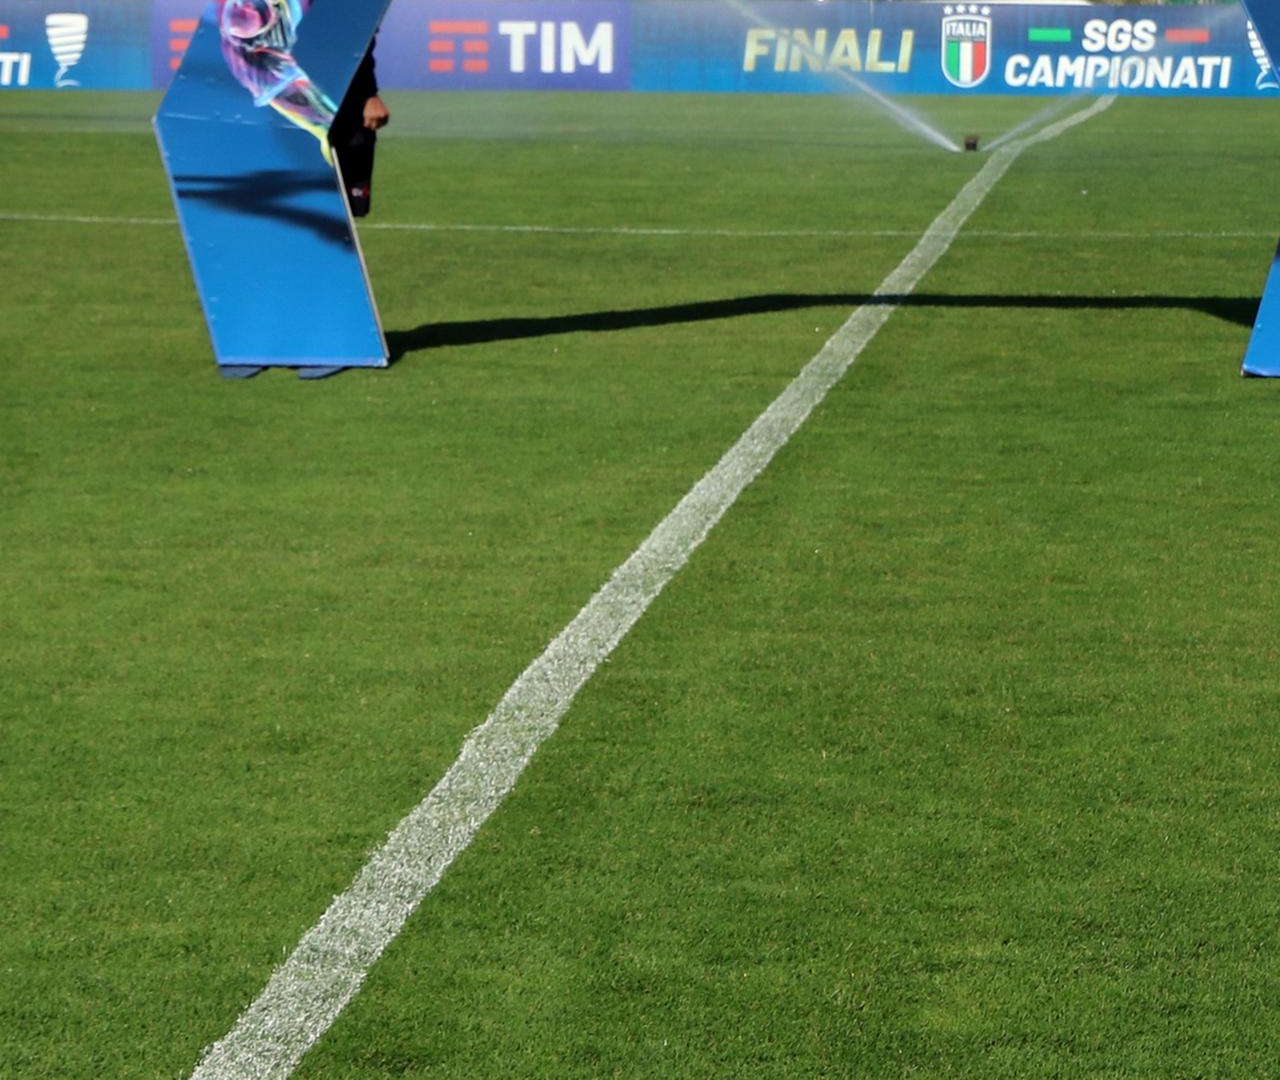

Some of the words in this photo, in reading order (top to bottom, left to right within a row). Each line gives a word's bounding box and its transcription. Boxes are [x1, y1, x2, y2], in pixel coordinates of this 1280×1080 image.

[945, 21, 986, 36] ITALIA
[1082, 19, 1156, 52] SGS
[498, 20, 613, 73] TIM
[742, 27, 916, 74] FINALI
[1004, 54, 1231, 89] CAMPIONATI
